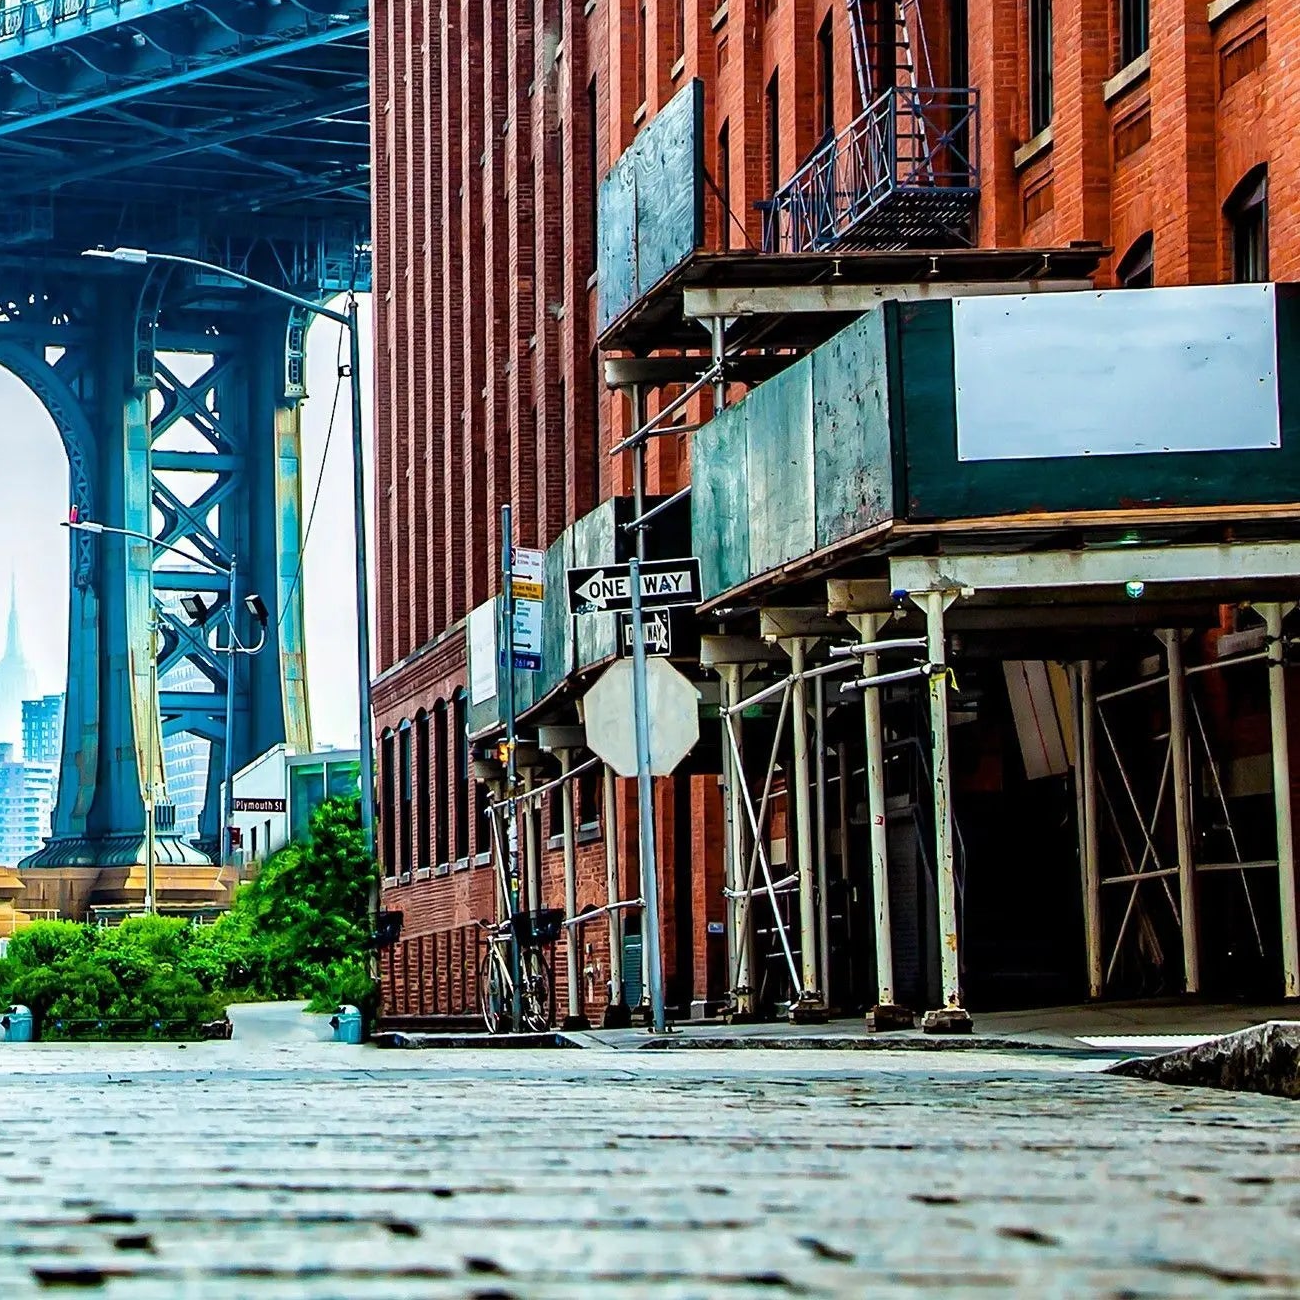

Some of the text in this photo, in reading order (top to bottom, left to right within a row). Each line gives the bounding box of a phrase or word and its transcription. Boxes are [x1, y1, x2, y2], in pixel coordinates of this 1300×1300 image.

[589, 573, 683, 599] ONE WAY
[647, 624, 662, 641] WAY
[236, 801, 283, 812] Plymouth St
